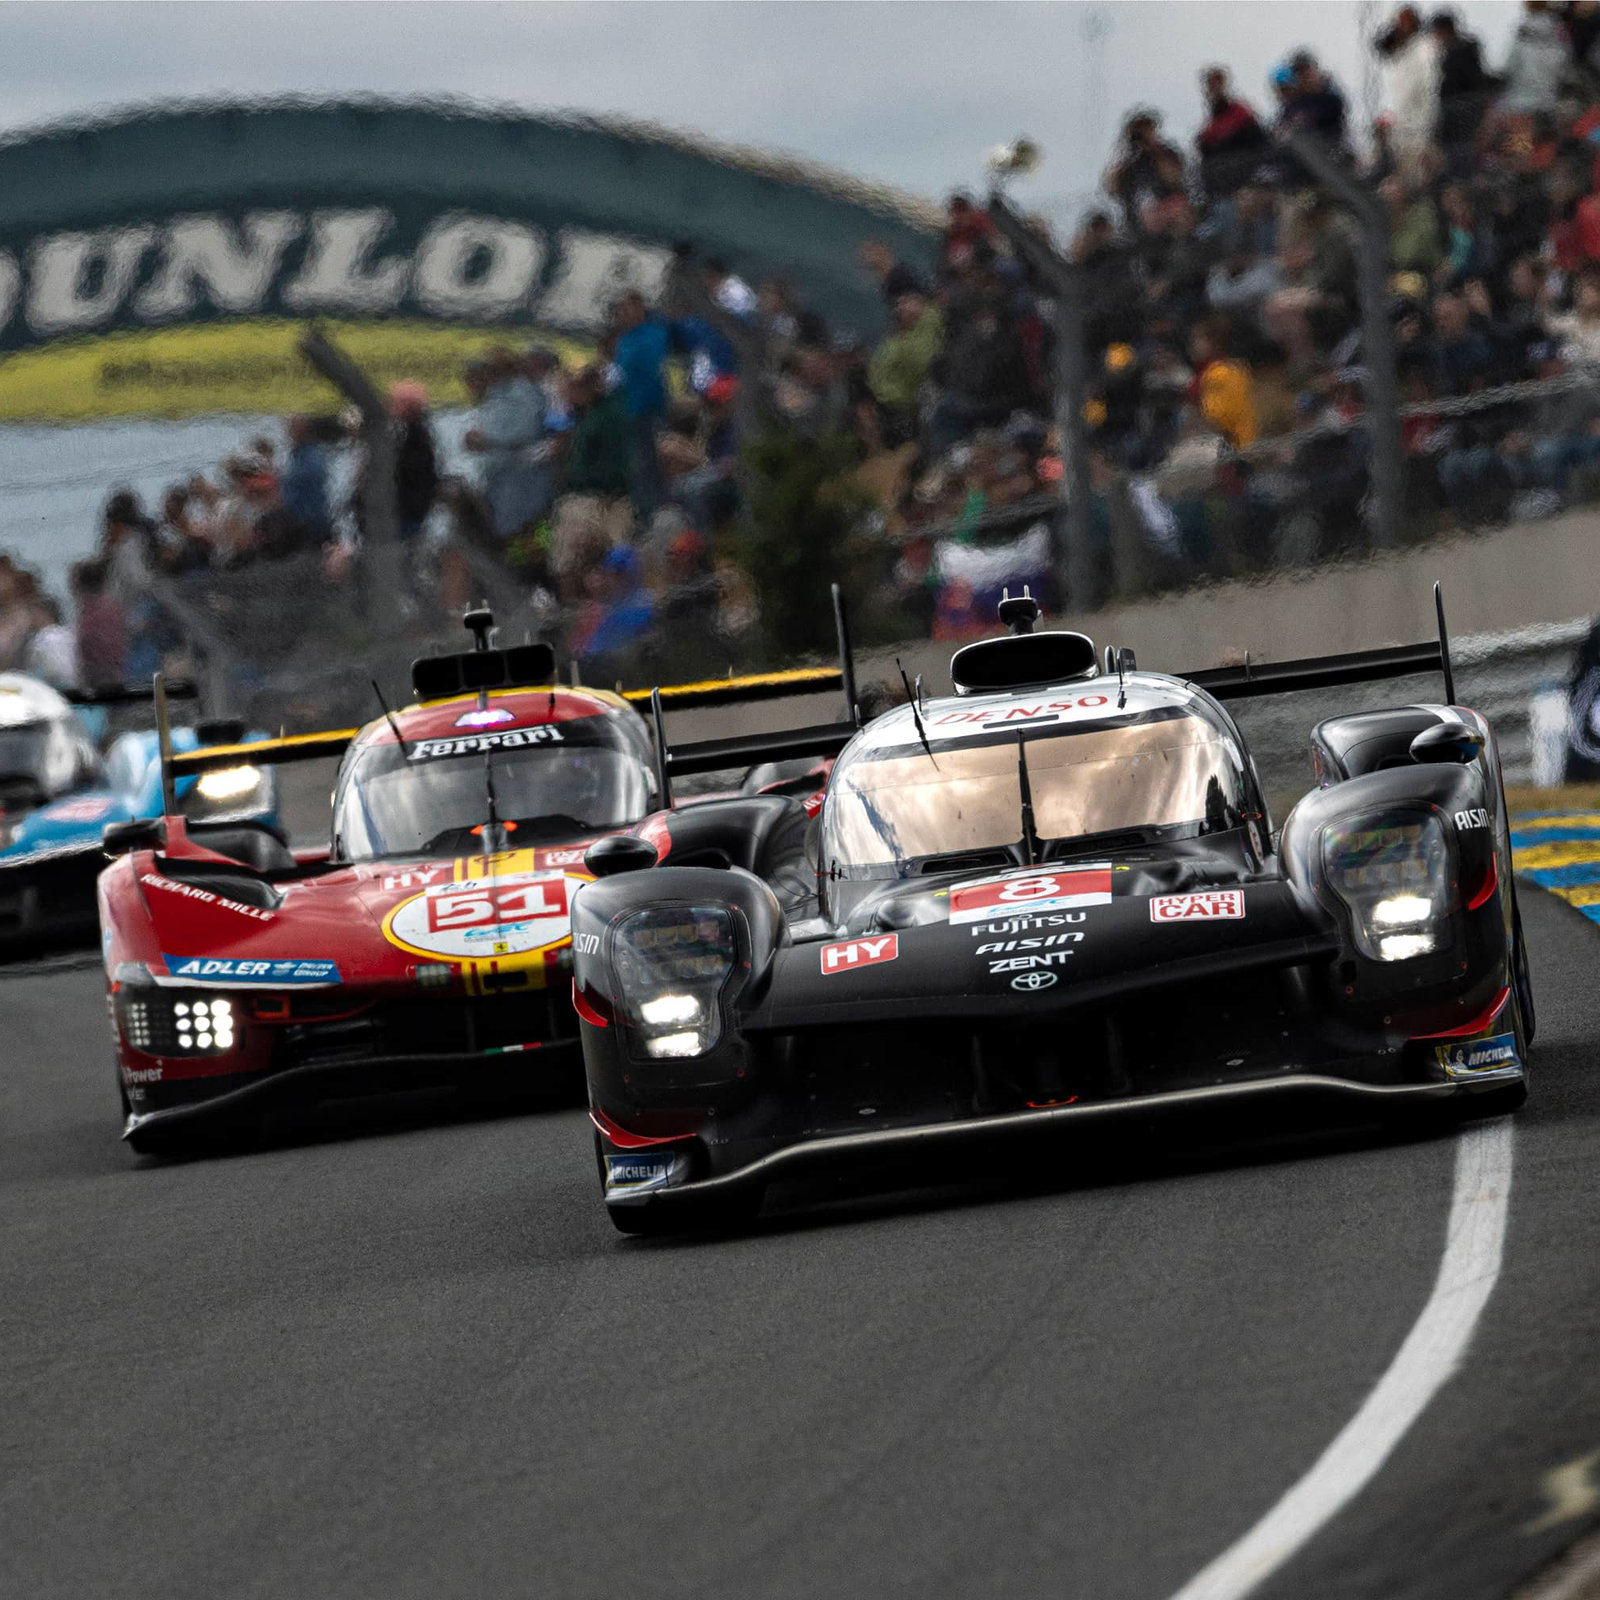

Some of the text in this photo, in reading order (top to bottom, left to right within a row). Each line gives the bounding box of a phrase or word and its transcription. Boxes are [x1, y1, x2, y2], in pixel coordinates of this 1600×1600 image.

[0, 205, 675, 335] UNLOP
[933, 695, 1108, 726] DENSO
[407, 723, 565, 760] Ferrari
[1454, 808, 1490, 830] AISIN
[384, 869, 440, 891] HY
[998, 877, 1061, 901] 8
[140, 873, 275, 921] RICHARD MILLE
[435, 884, 562, 927] 51
[1158, 893, 1235, 905] HYPER
[1159, 901, 1236, 918] CAR
[971, 912, 1087, 937] FUJITSU
[827, 938, 892, 968] HY
[975, 931, 1085, 955] AISIN
[176, 960, 272, 976] ADLER
[988, 950, 1074, 974] ZENT
